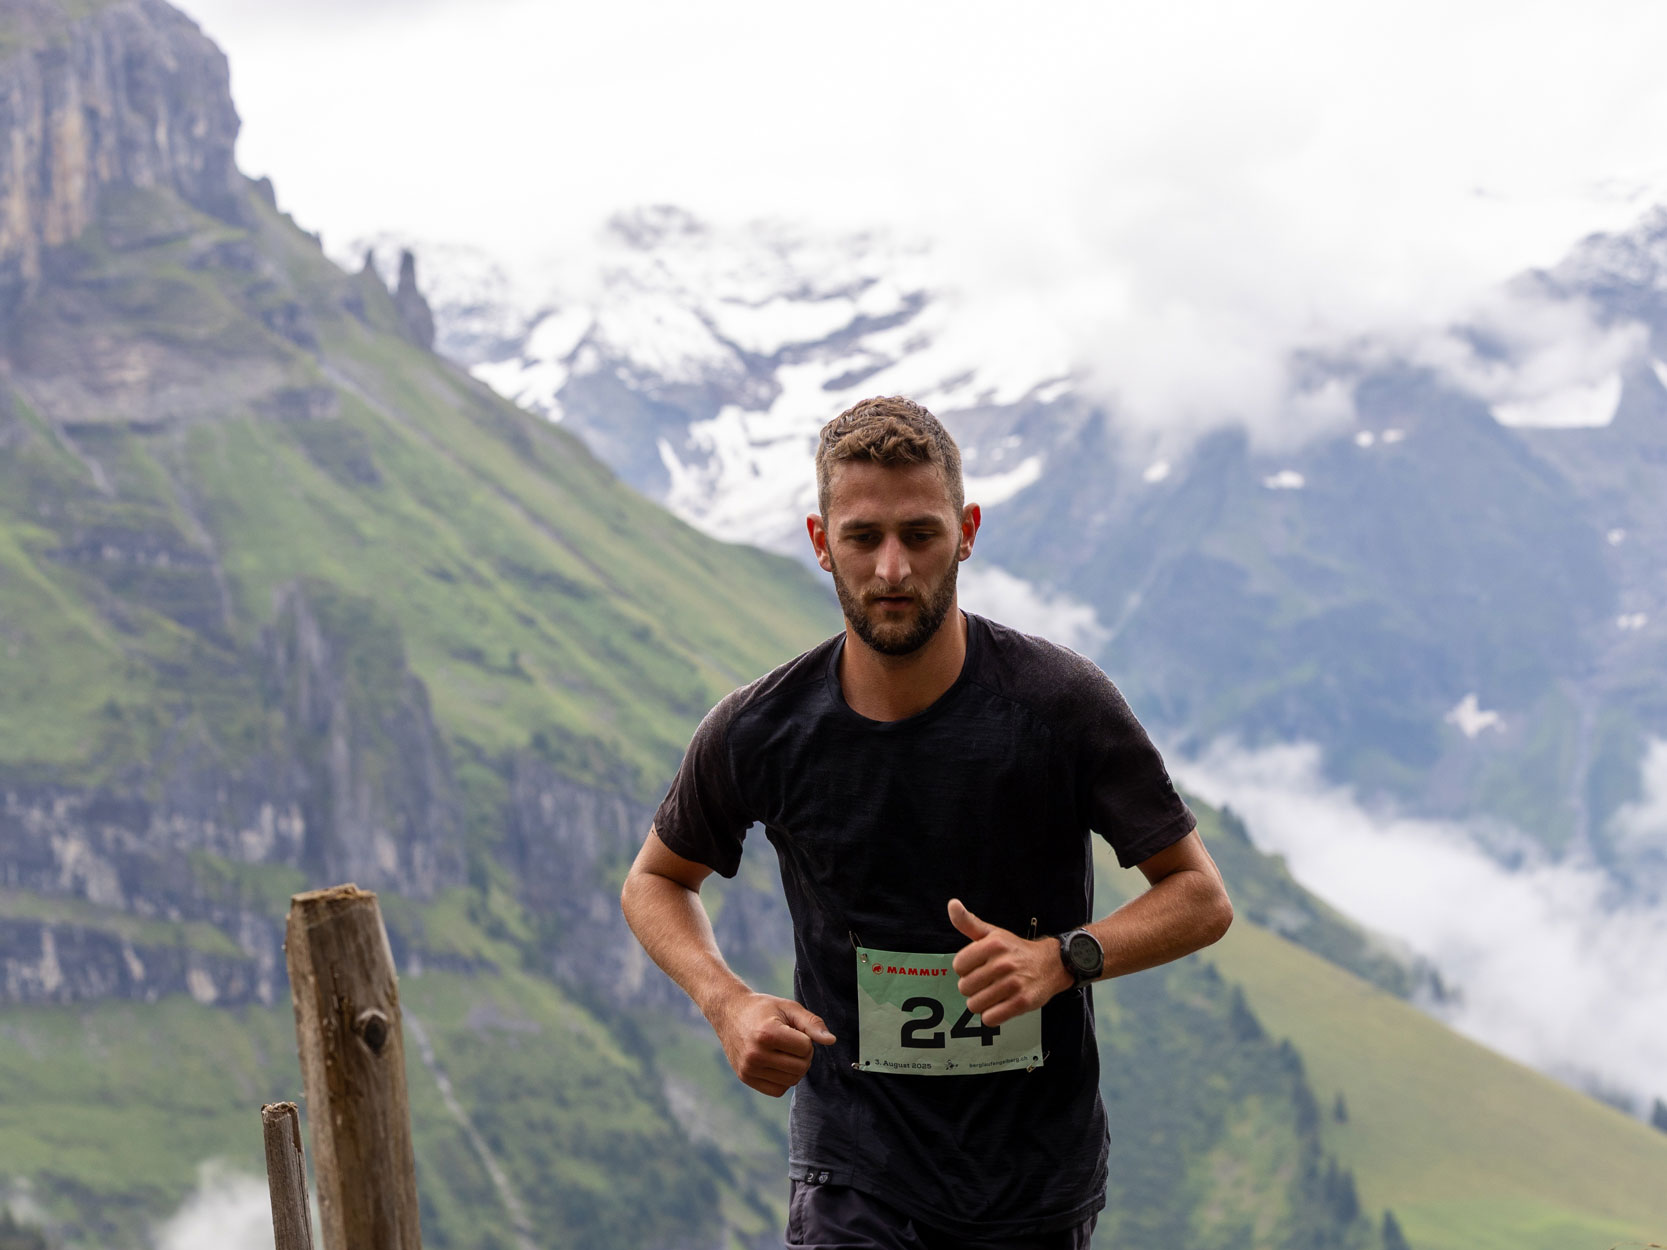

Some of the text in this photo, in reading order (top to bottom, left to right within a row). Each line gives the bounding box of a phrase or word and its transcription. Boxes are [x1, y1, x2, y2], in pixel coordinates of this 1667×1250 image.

[887, 966, 948, 976] MAMMUT
[901, 996, 1000, 1048] 24
[883, 1060, 910, 1069] August
